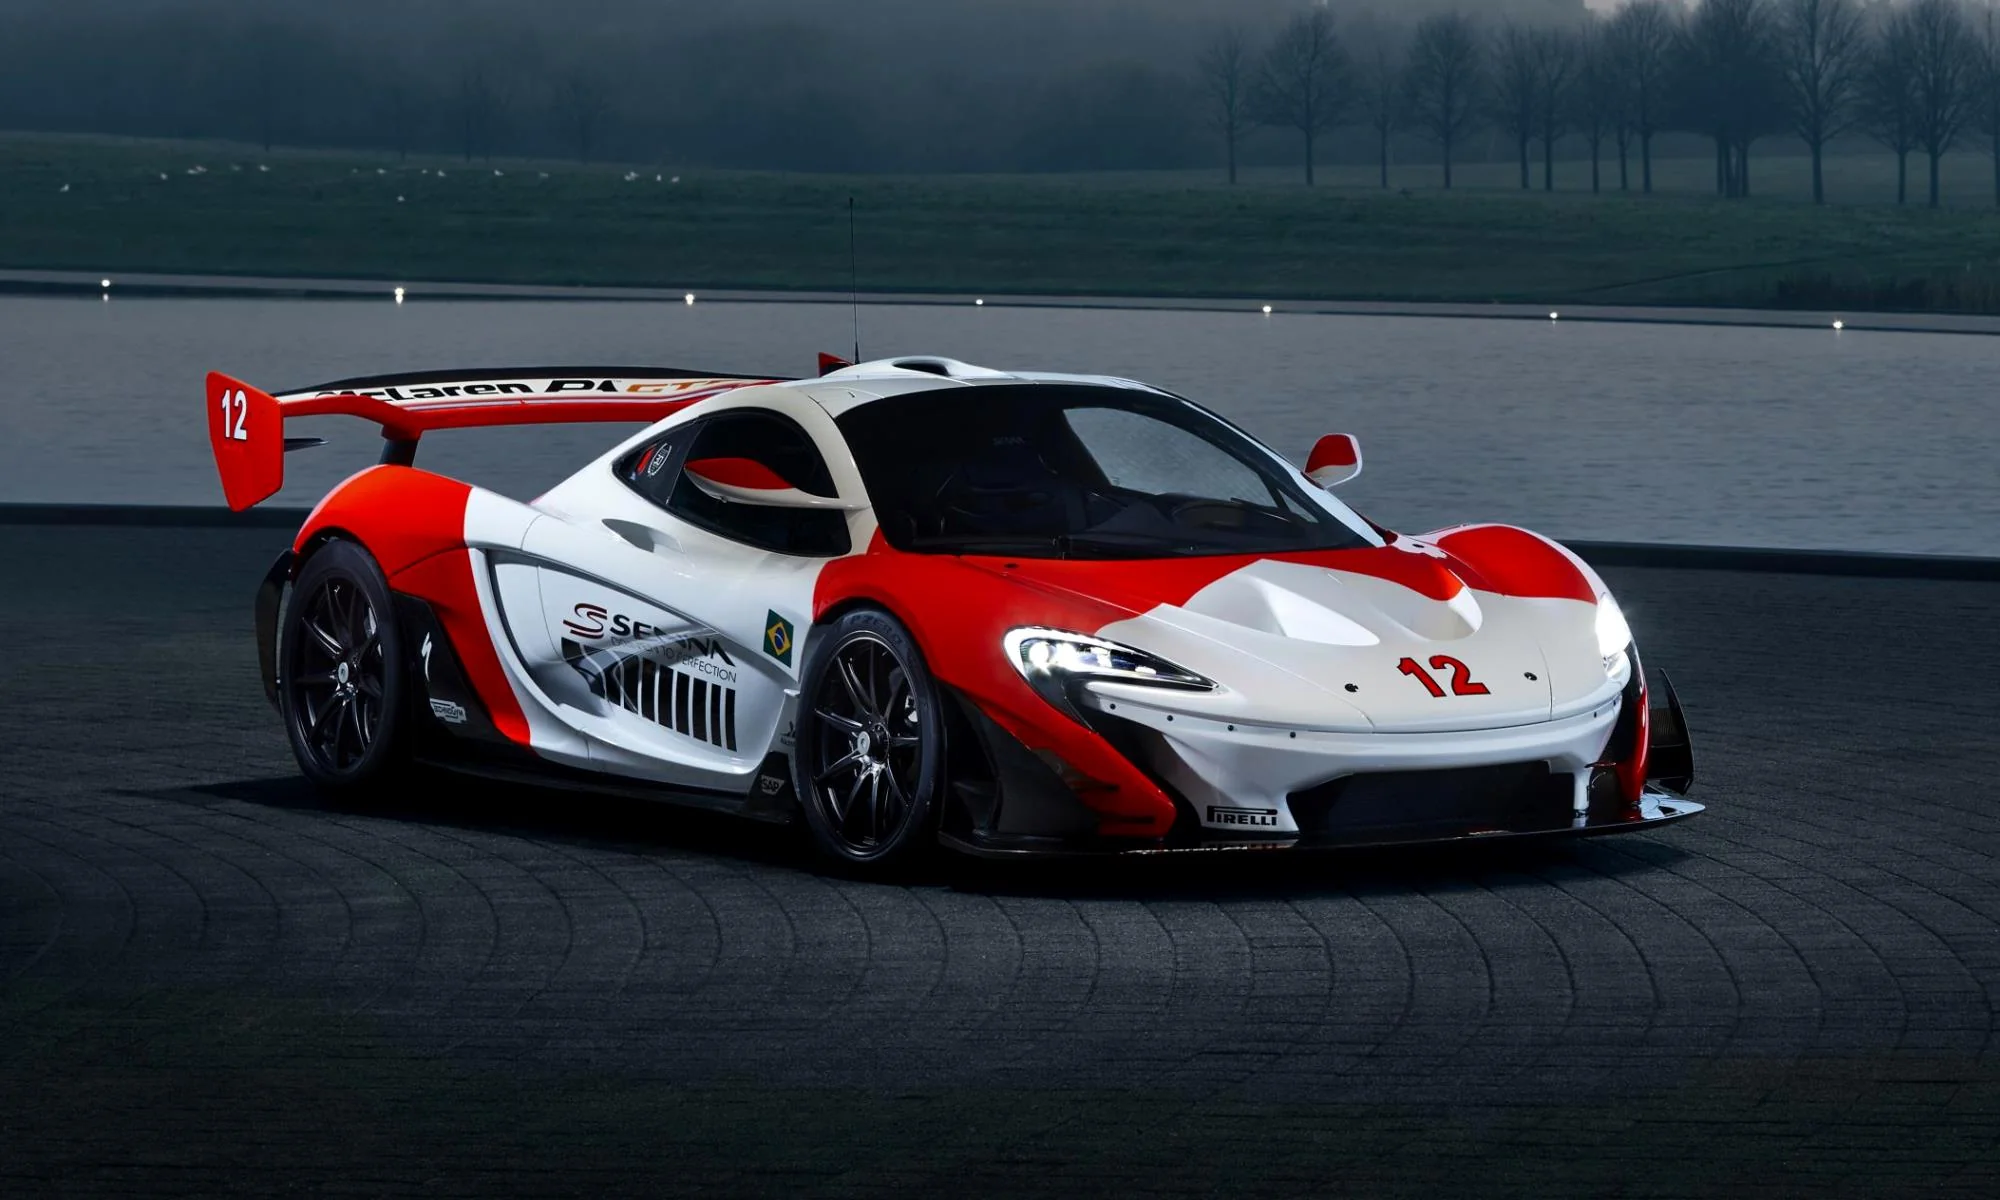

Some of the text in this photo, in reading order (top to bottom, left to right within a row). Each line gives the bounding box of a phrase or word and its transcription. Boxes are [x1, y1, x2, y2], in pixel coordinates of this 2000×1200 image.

[221, 389, 248, 441] 12
[677, 651, 737, 684] PERFECTION
[1397, 654, 1491, 698] 12
[1206, 805, 1278, 826] PIRELLI
